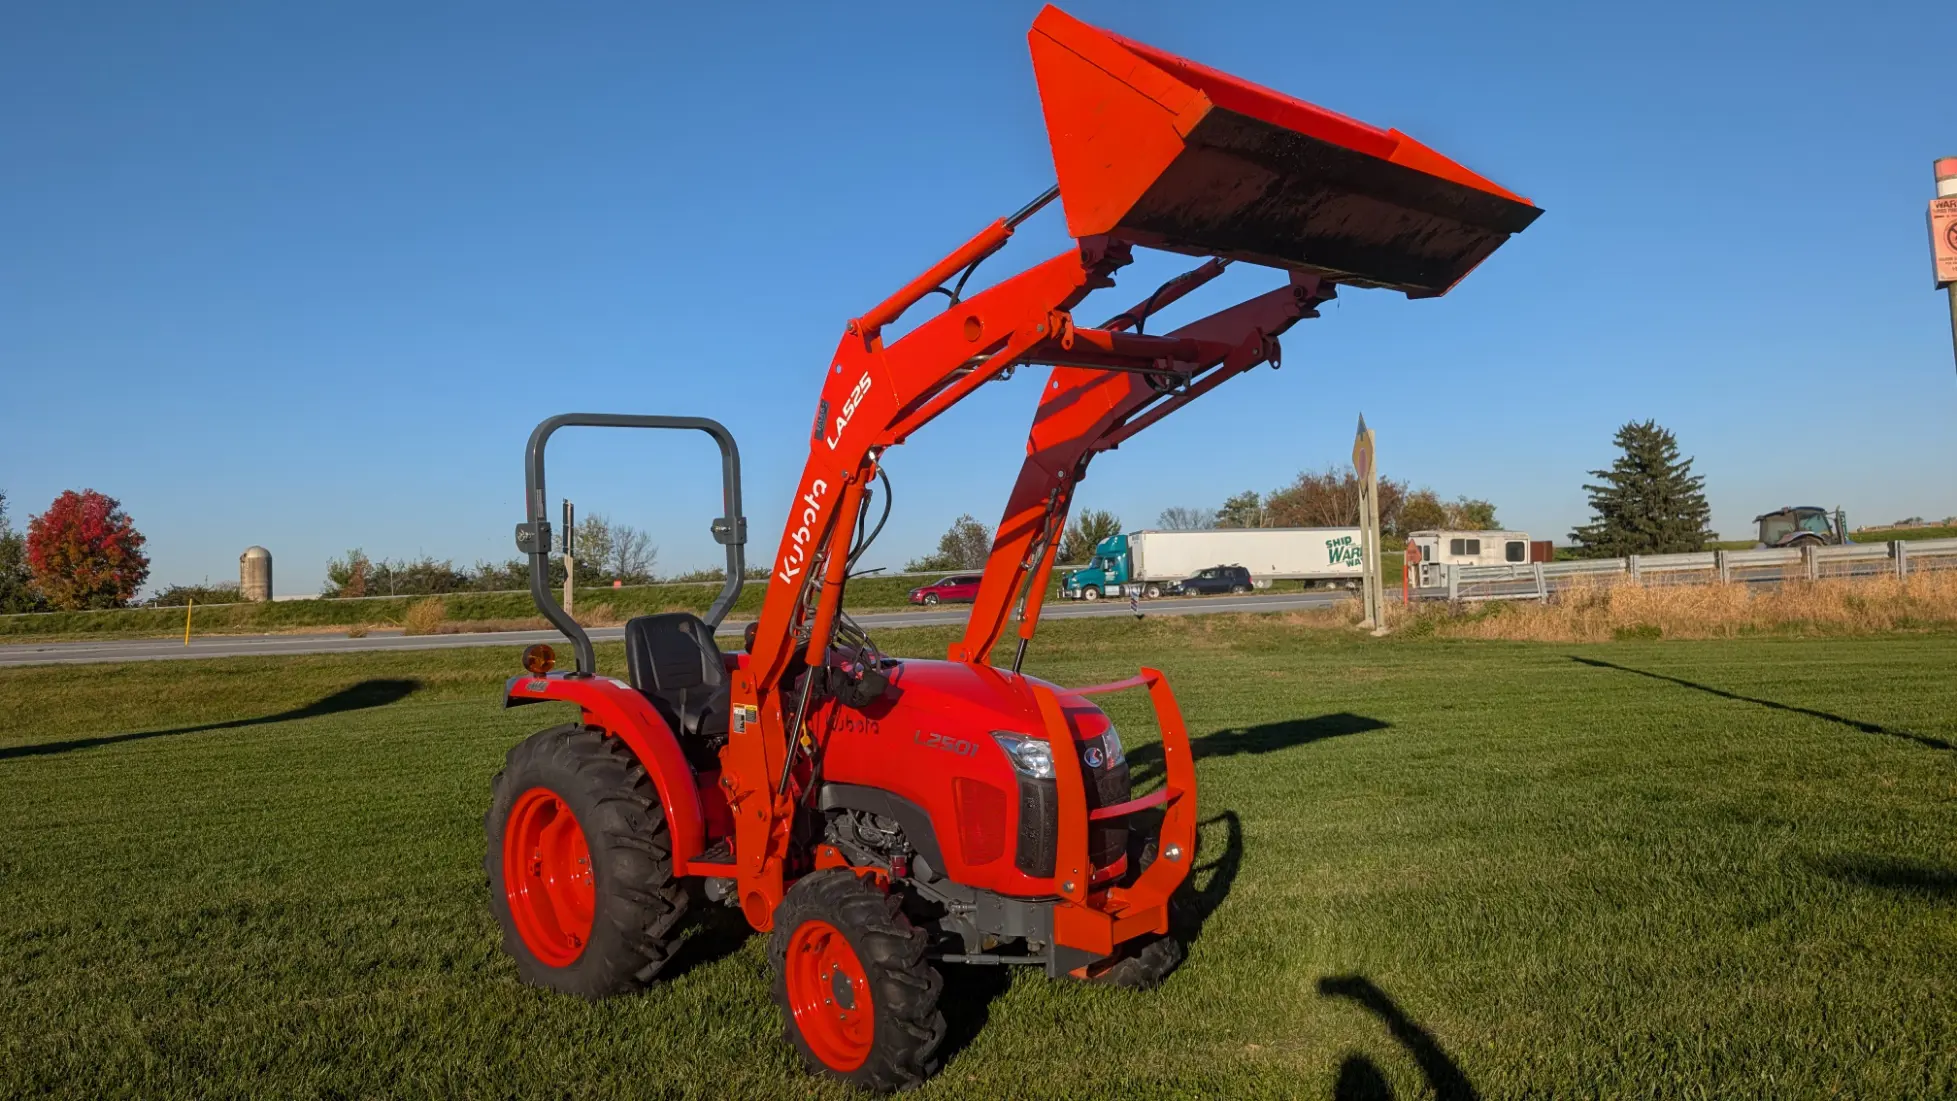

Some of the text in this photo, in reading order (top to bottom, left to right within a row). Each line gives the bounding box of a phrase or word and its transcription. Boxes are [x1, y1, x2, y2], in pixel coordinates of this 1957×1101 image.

[826, 371, 872, 450] LA525
[779, 479, 828, 584] Kubota
[1325, 536, 1352, 549] SHIP
[1328, 546, 1363, 564] WAR
[1346, 557, 1363, 567] WA
[913, 729, 980, 758] L2501
